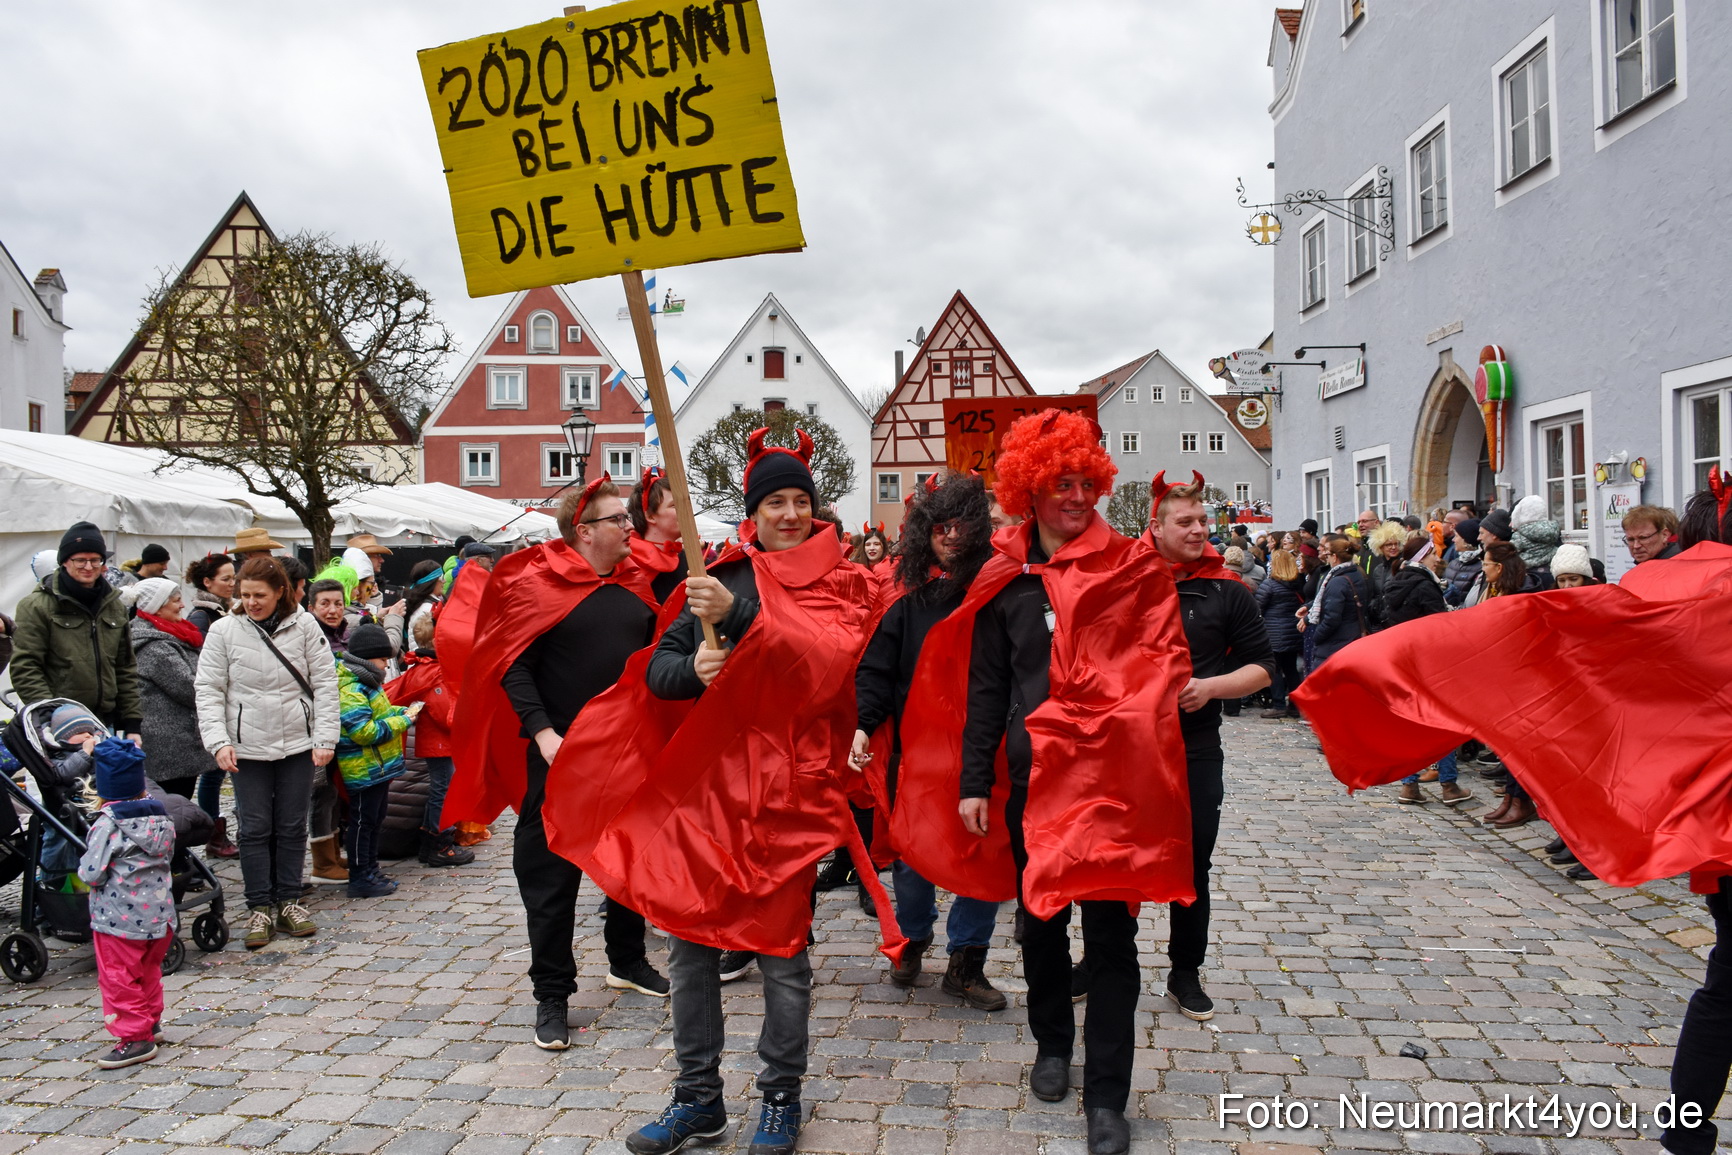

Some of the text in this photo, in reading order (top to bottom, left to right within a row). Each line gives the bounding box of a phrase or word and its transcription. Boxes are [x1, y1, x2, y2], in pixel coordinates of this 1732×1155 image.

[438, 0, 751, 132] 2020 BRENNT
[512, 73, 715, 178] BEI UNS
[490, 156, 785, 265] DIE HÜTTE
[949, 409, 996, 434] 125
[1615, 493, 1630, 507] Eis
